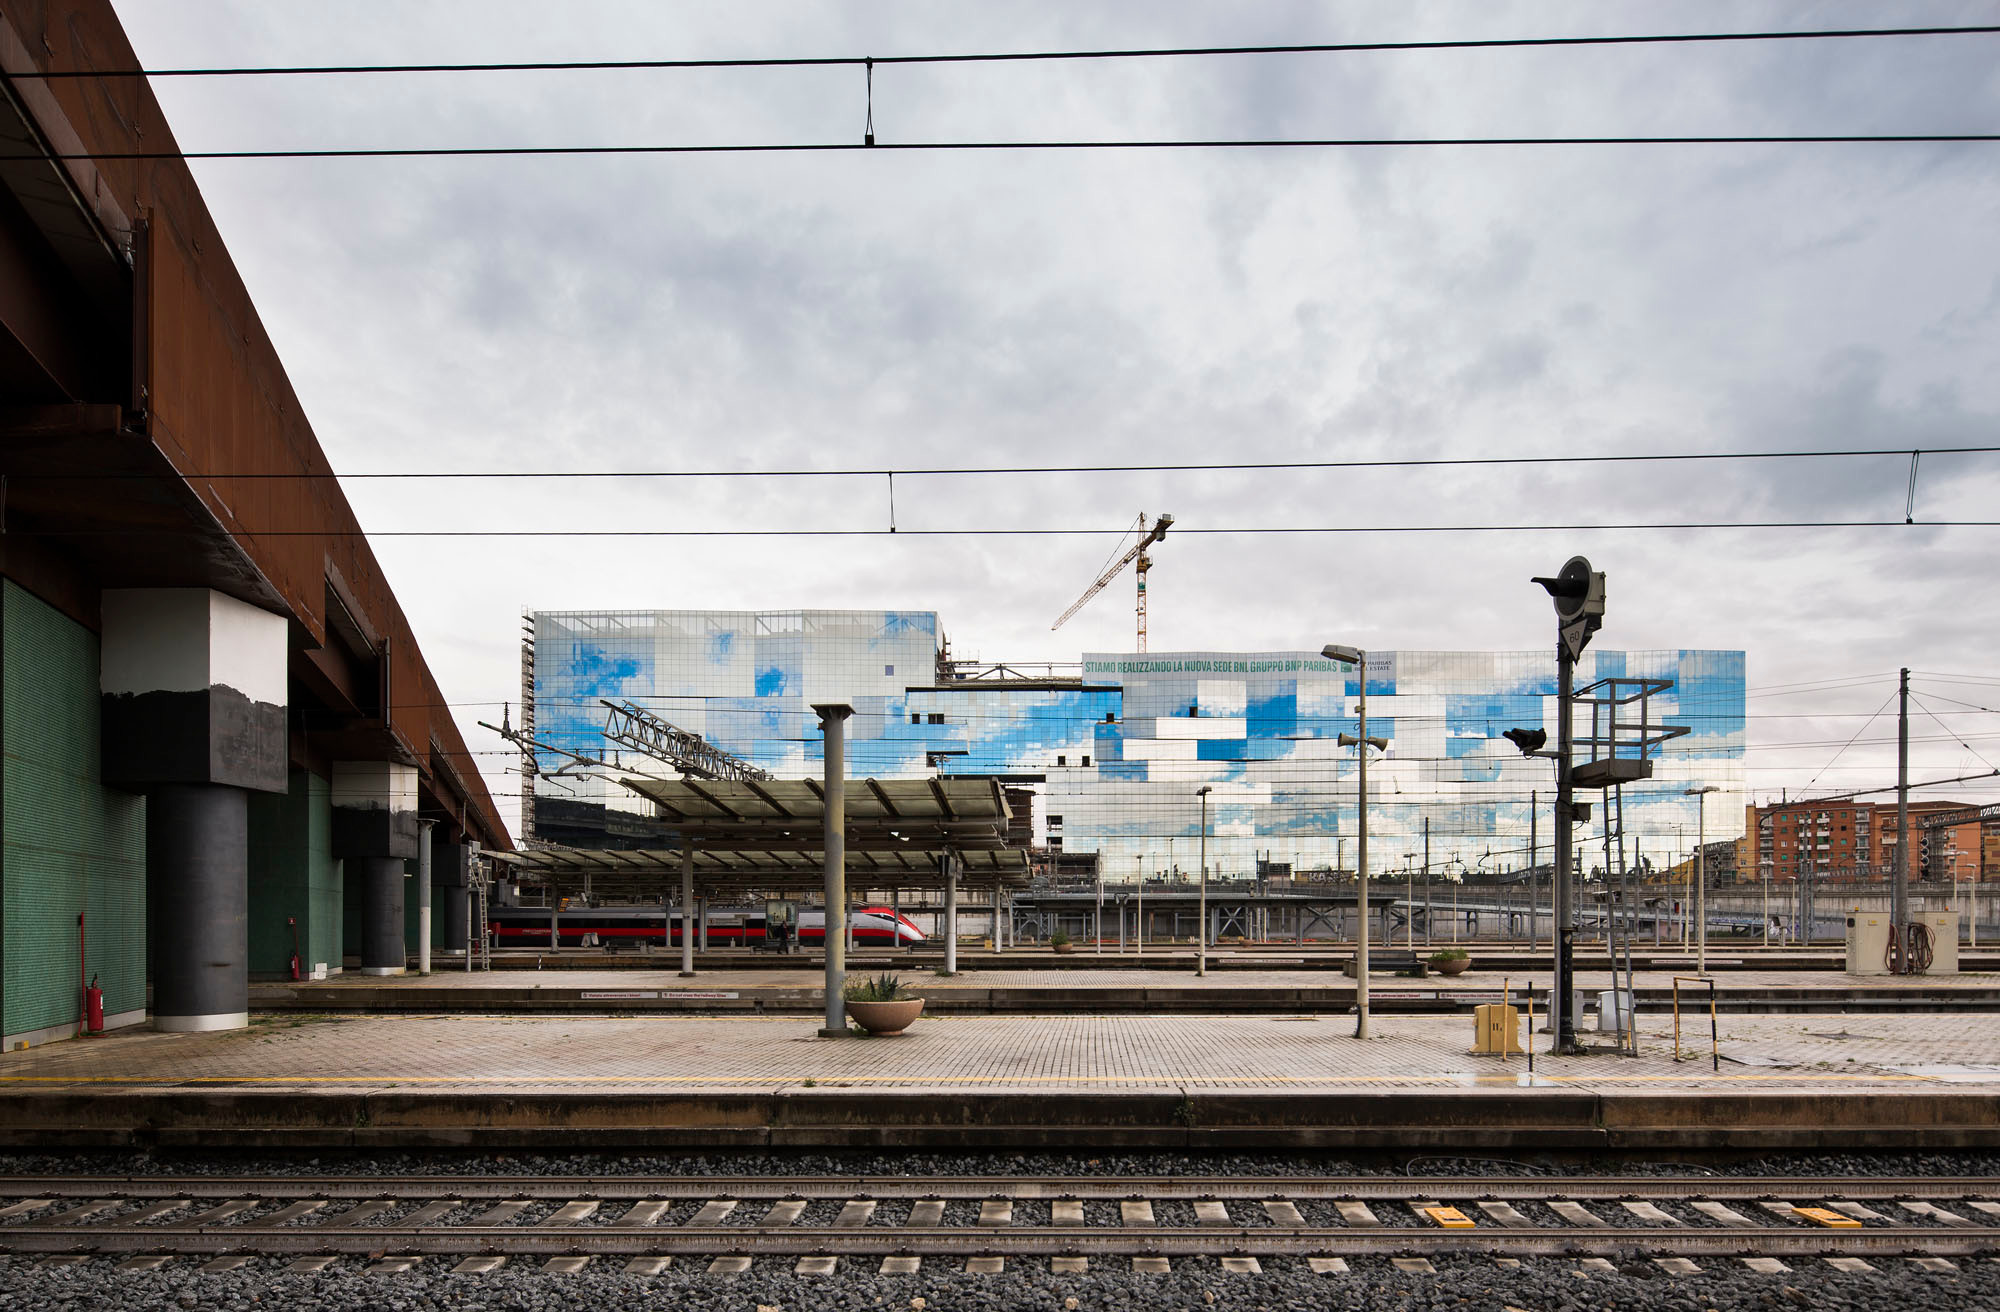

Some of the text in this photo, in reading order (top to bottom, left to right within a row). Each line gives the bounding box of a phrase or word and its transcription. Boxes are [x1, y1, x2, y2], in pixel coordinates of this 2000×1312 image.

[1570, 631, 1580, 643] 60
[1085, 661, 1115, 673] STIAMO
[1117, 661, 1171, 673] REALIZZANDO
[1173, 661, 1183, 672] LA
[1184, 660, 1212, 672] NUOVA
[1213, 661, 1232, 672] SEDE
[1233, 661, 1249, 672] BNL
[1250, 660, 1283, 672] GRUPPO
[1285, 660, 1302, 672] BNP
[1303, 660, 1337, 672] PARIBAS
